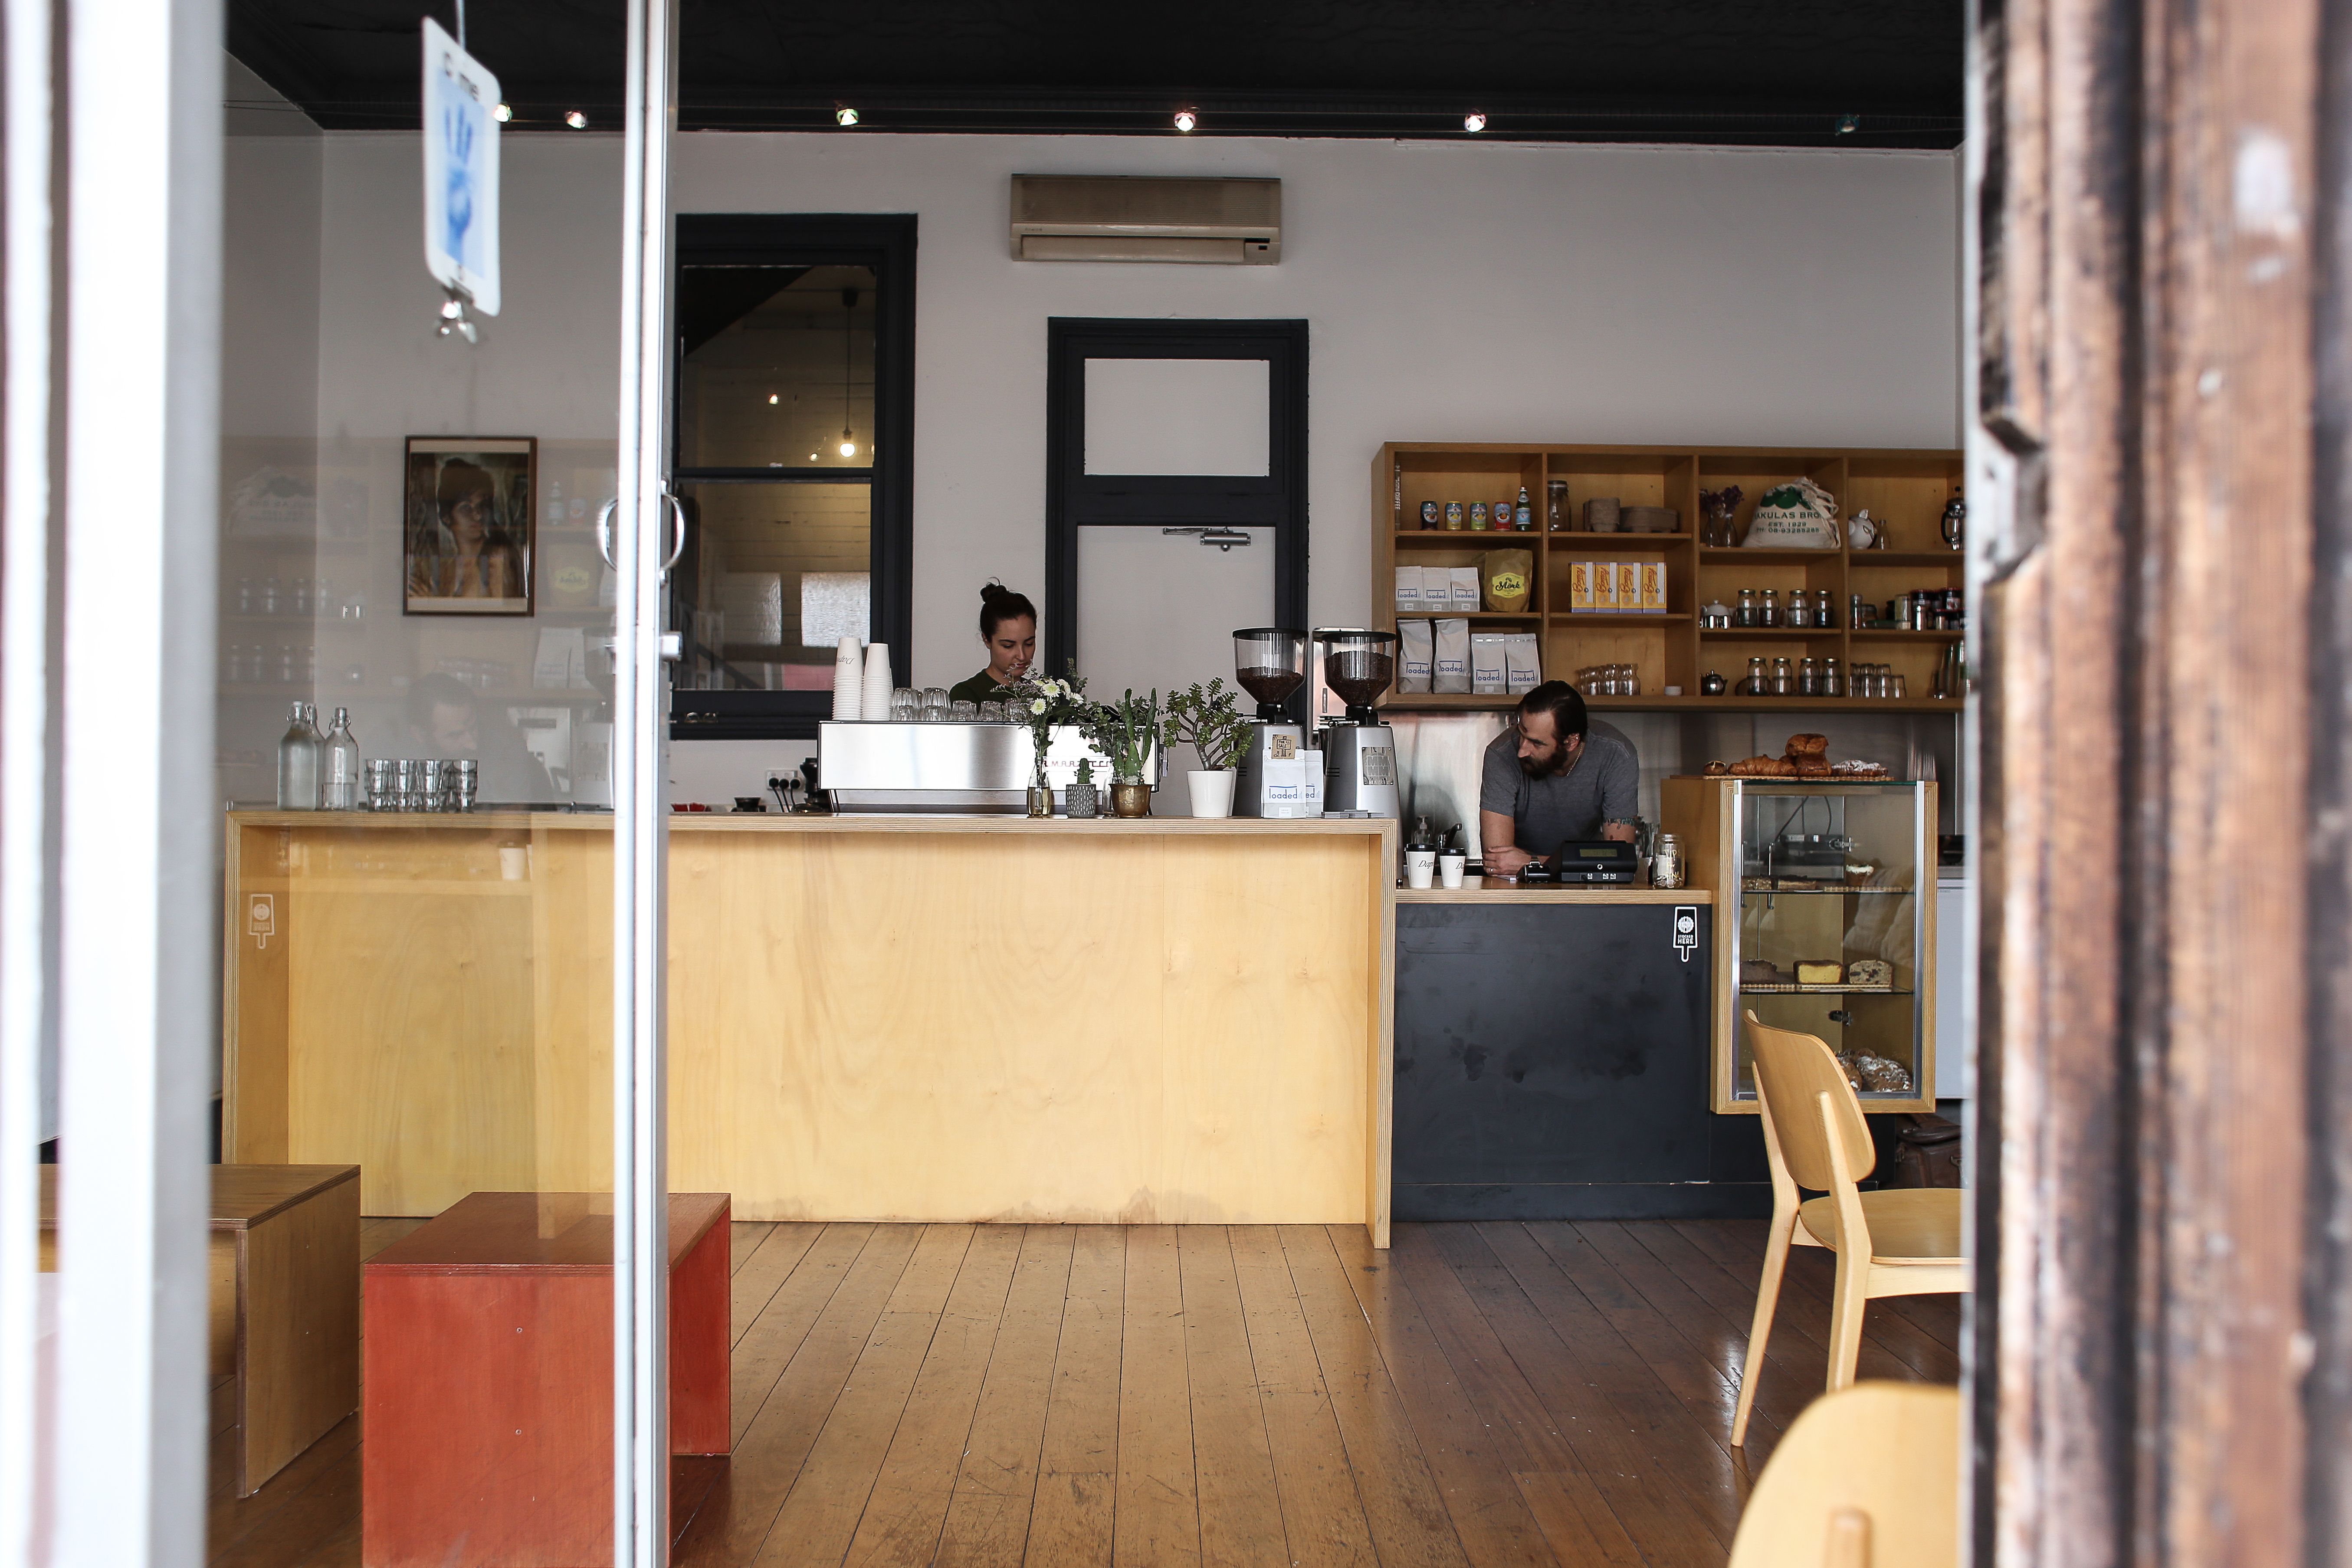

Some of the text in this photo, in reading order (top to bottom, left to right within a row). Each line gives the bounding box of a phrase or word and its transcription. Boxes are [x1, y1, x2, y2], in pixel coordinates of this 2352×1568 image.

[1406, 664, 1430, 674] loaded
[1439, 663, 1463, 672] loaded
[1476, 671, 1499, 681] loaded
[1511, 672, 1535, 682] loaded
[1269, 788, 1297, 799] loaded
[1418, 860, 1434, 869] Dap
